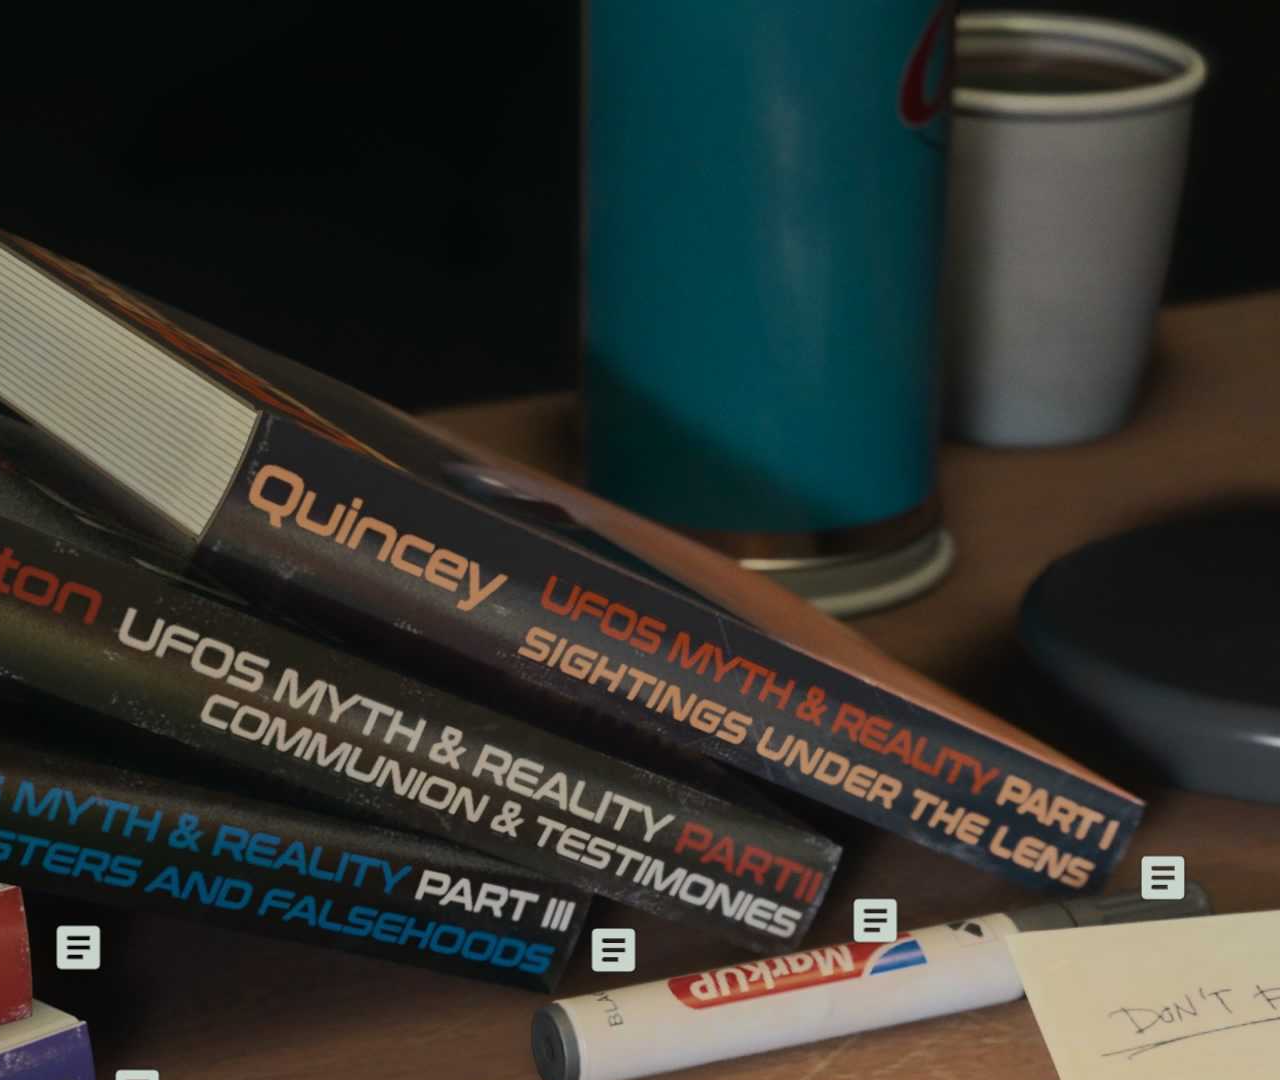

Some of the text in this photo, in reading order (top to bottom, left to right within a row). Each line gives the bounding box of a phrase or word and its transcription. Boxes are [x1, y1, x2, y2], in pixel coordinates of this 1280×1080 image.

[248, 464, 508, 611] Quincey
[119, 607, 270, 693] UFOS
[273, 667, 427, 753] MYTH
[428, 725, 467, 771] &
[472, 743, 675, 844] REALITY
[518, 626, 1096, 890] SIGHTINGS UNDER THE LENS
[541, 575, 1120, 852] UFOS MYTH & REALITY PART I
[12, 778, 164, 843] MYTH
[168, 811, 202, 853] &
[212, 824, 413, 895] REALITY
[414, 868, 540, 923] PART
[544, 896, 578, 934] III
[200, 693, 803, 939] COMMUNION & TESTIMONIES
[144, 863, 254, 912] AND
[256, 886, 558, 976] FALSEHOODS
[1108, 985, 1232, 1036] DON'T
